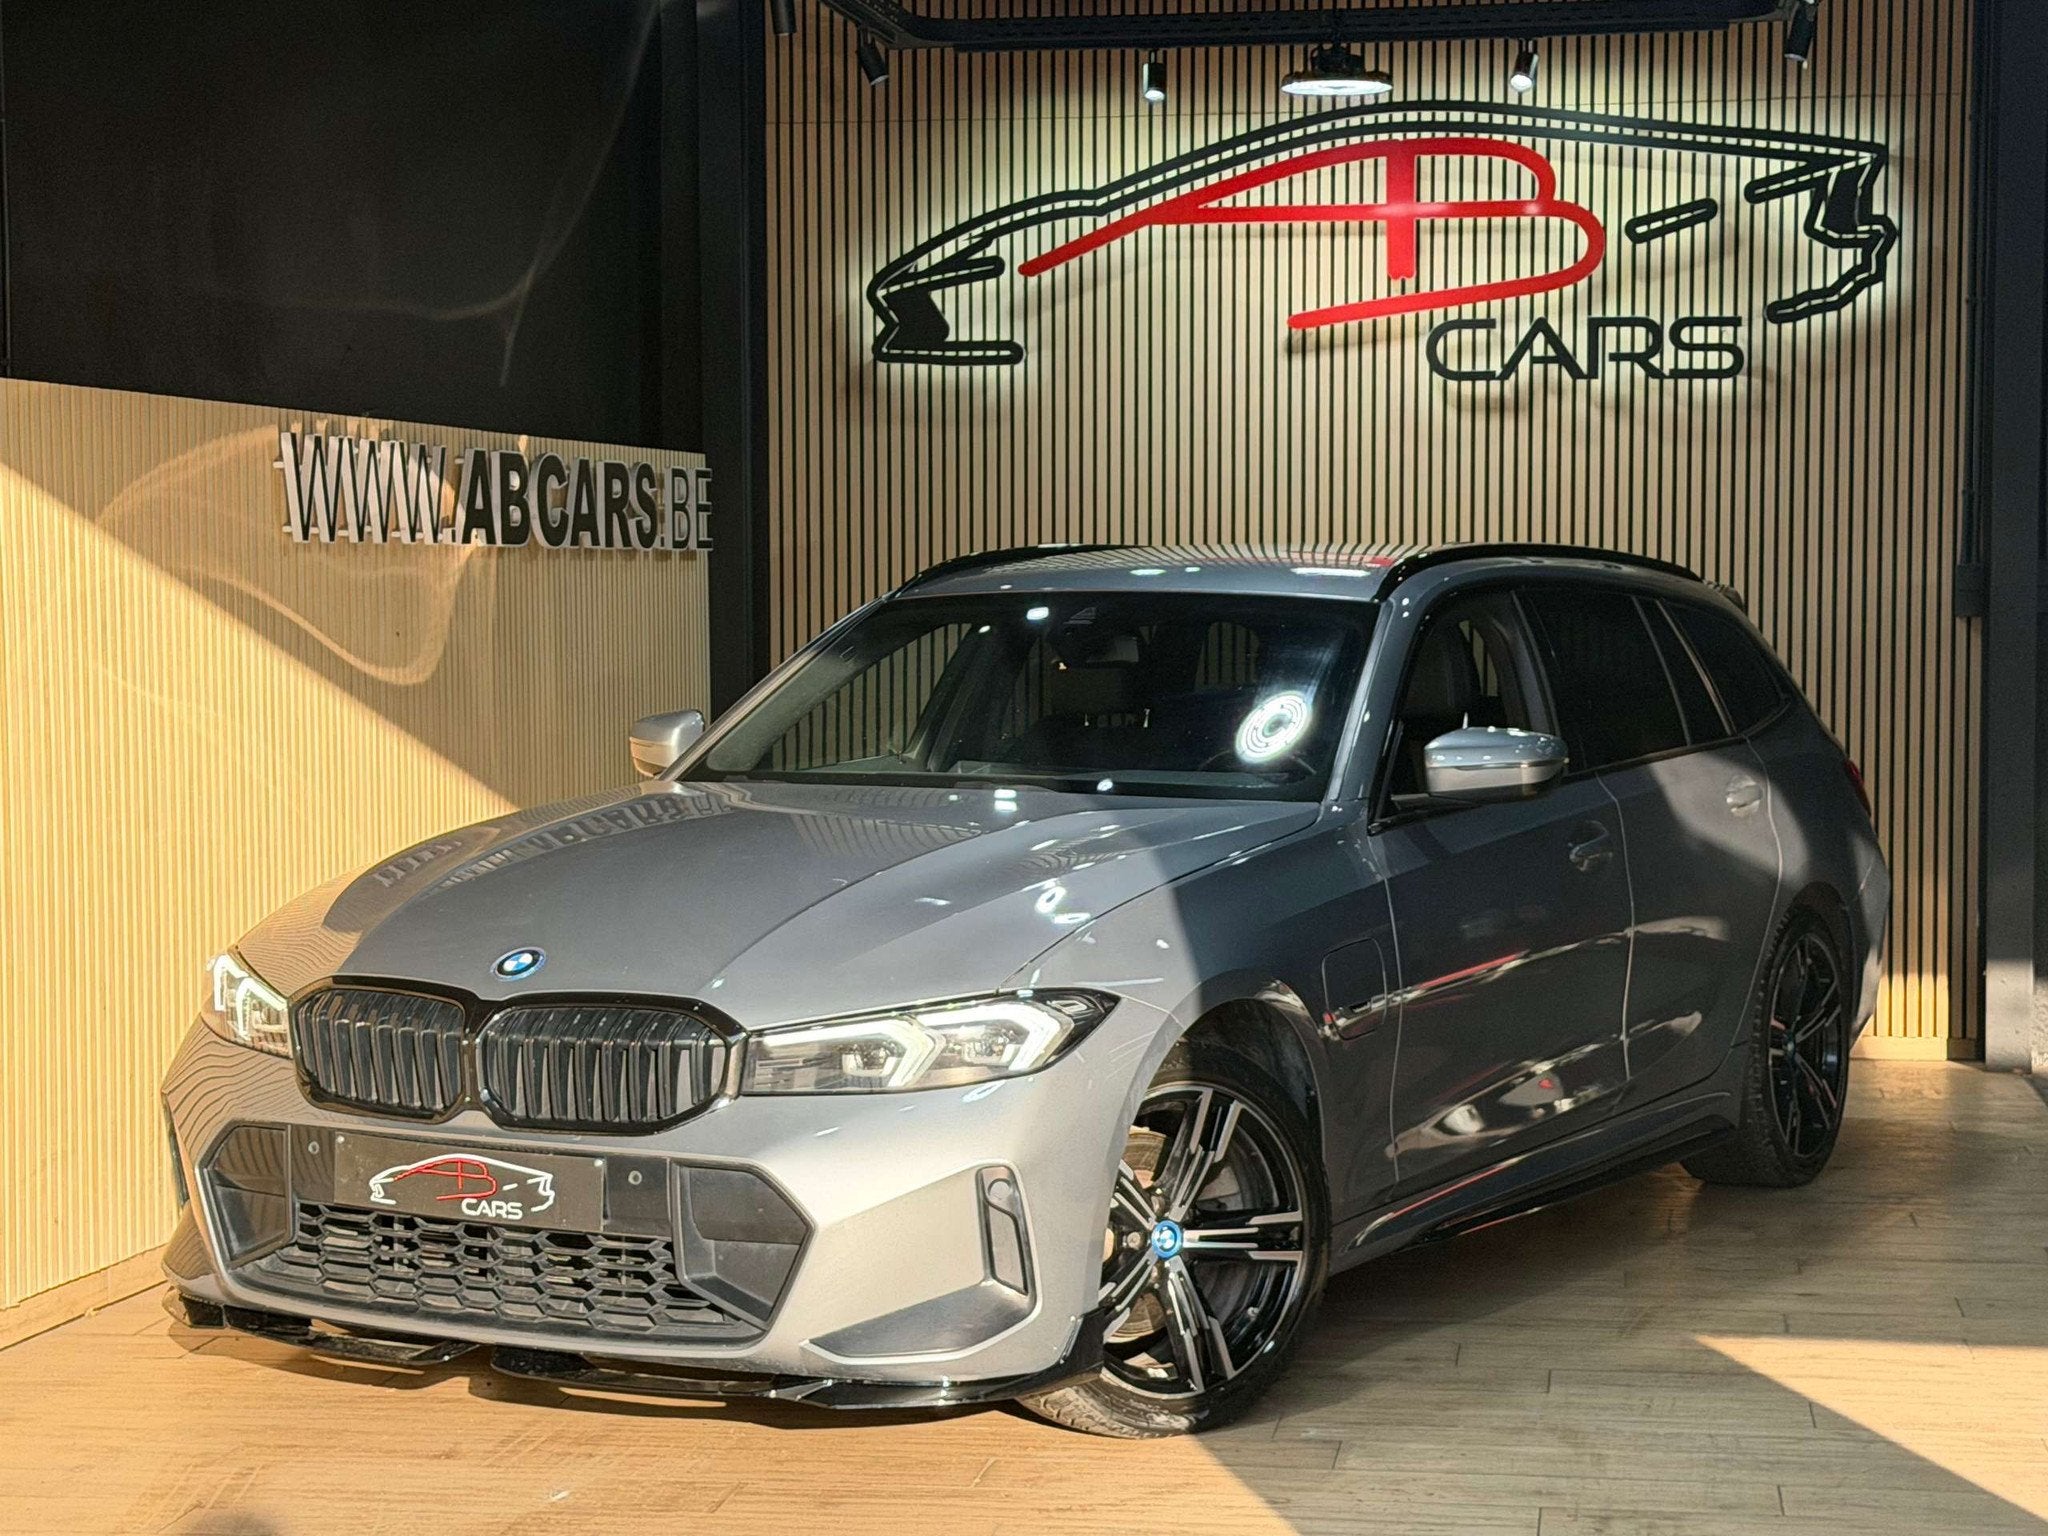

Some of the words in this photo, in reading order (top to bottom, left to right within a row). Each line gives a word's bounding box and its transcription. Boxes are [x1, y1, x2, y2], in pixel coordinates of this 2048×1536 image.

[1426, 316, 1745, 381] CARS
[280, 431, 713, 551] WWW.ABCARS.BE
[461, 1198, 523, 1220] CARS
